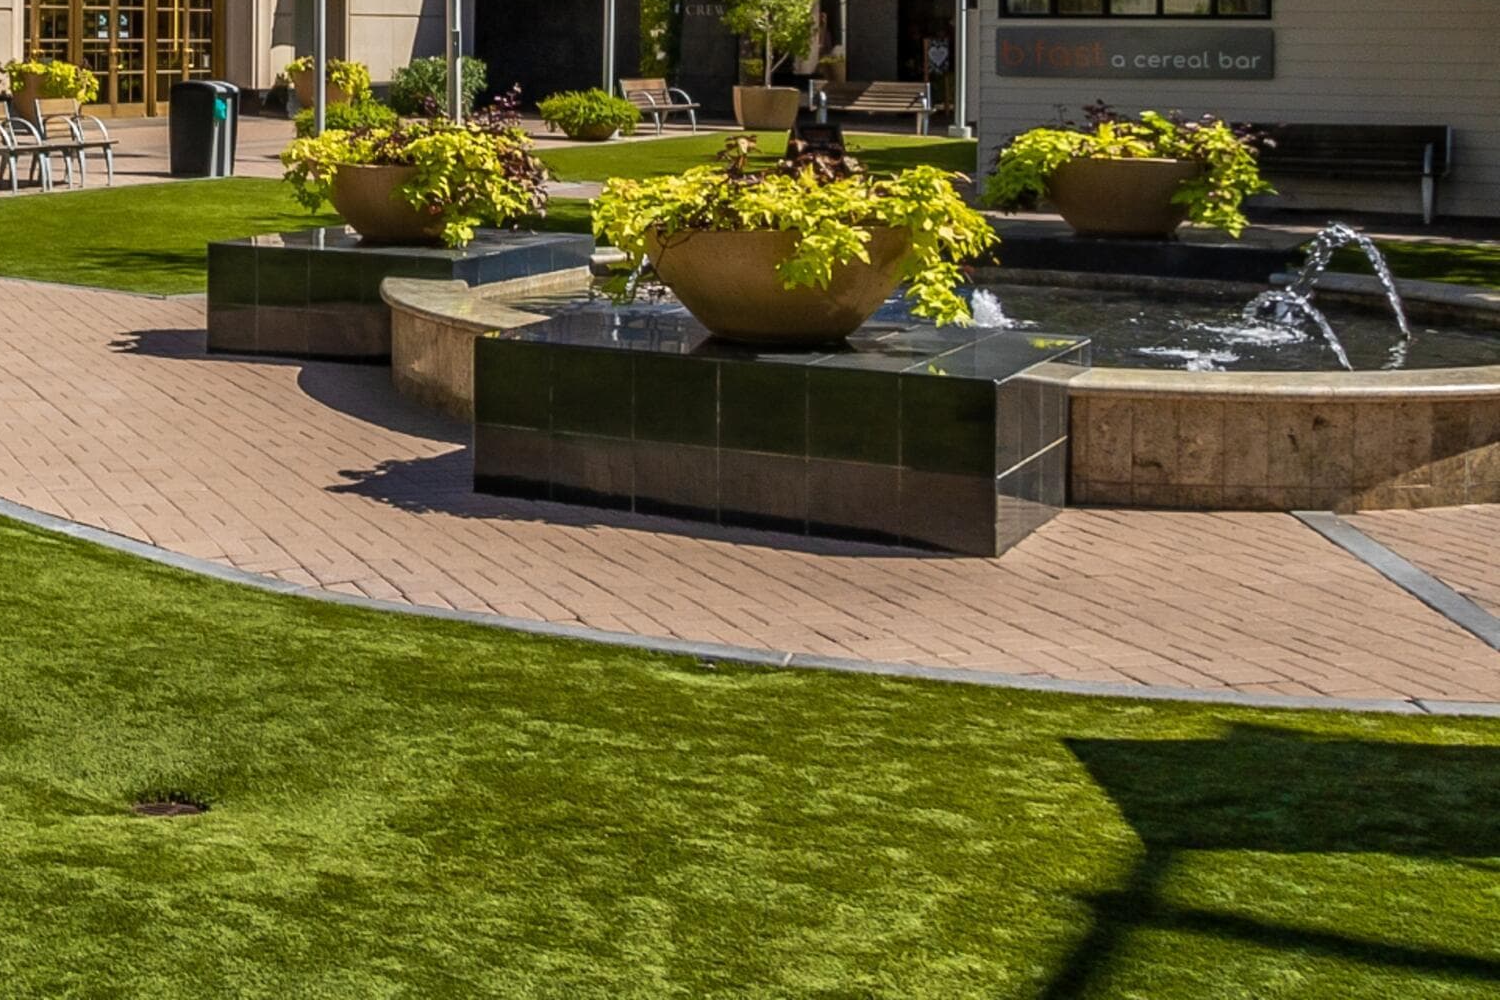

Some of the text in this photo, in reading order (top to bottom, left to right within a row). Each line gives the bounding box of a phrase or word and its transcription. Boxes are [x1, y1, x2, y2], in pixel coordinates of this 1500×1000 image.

[1111, 53, 1127, 68] a
[1133, 51, 1210, 69] cereal
[1218, 51, 1262, 70] bar
